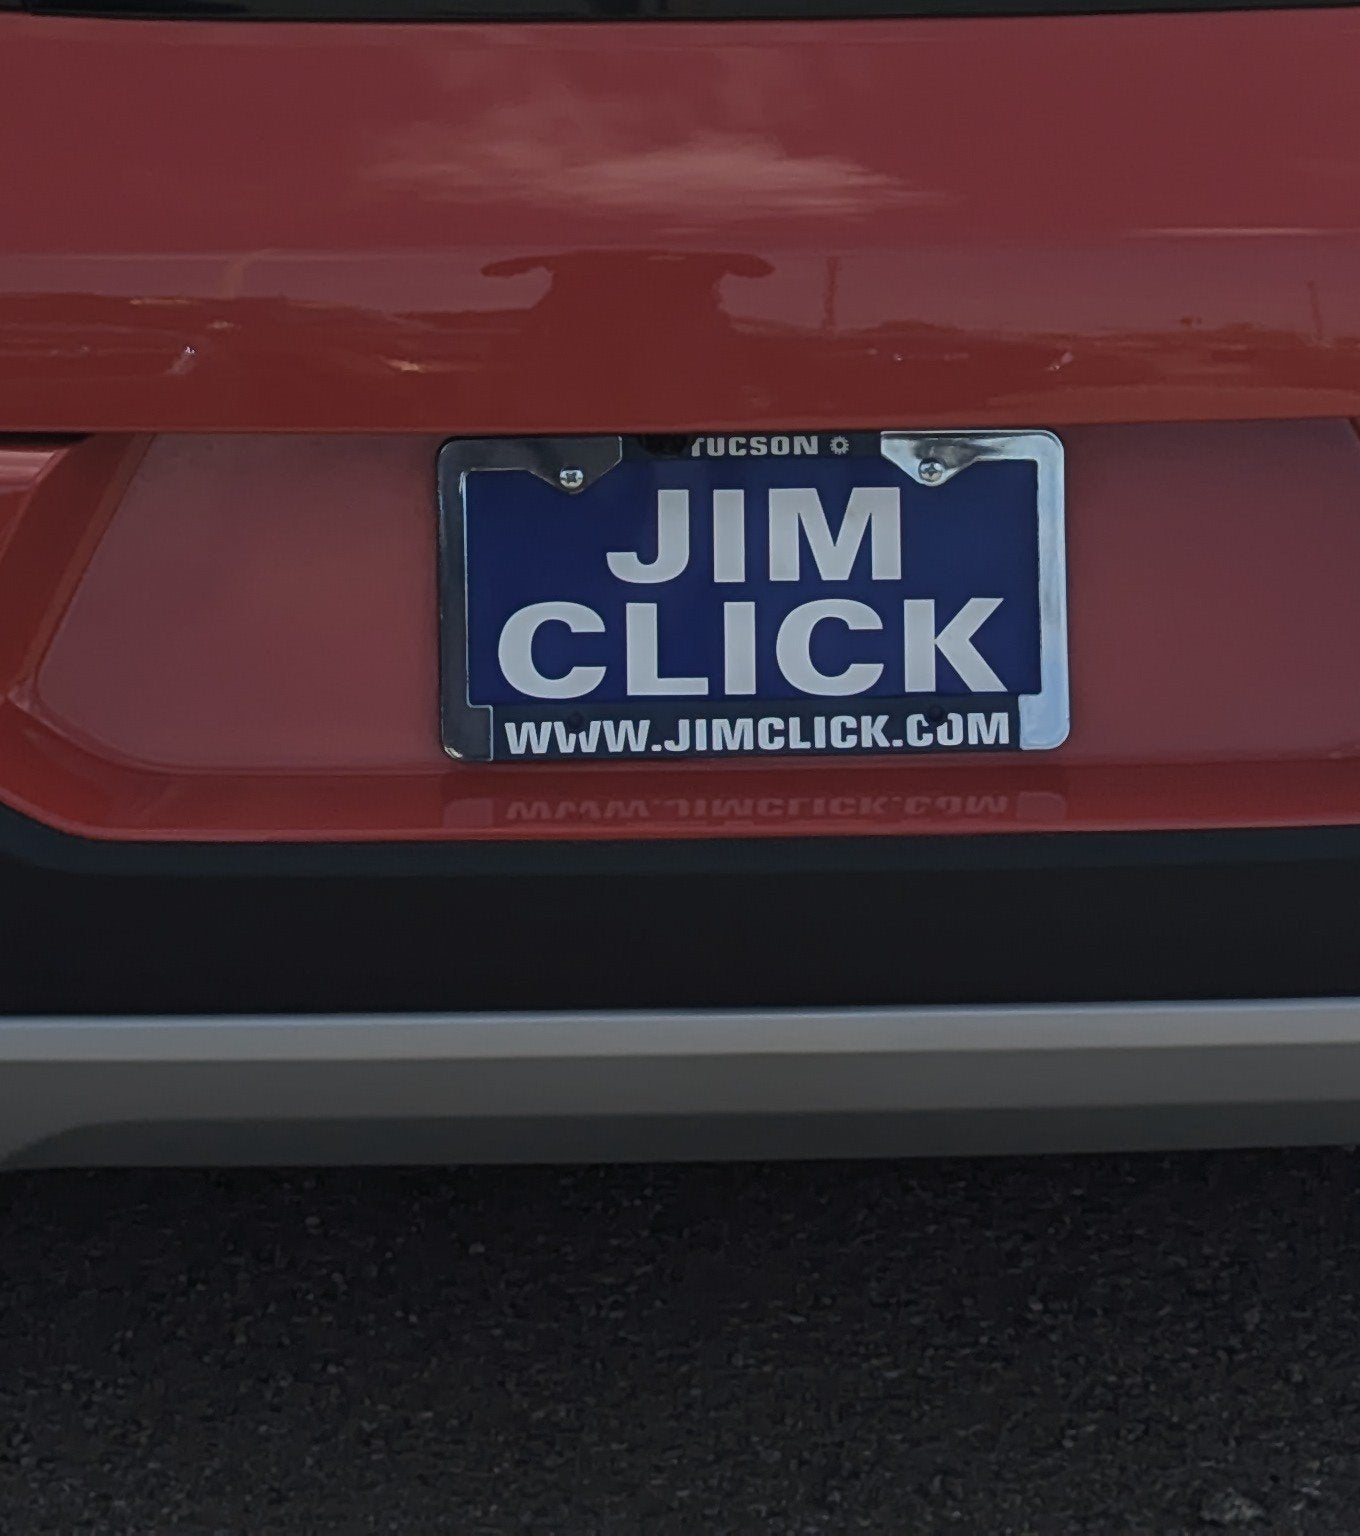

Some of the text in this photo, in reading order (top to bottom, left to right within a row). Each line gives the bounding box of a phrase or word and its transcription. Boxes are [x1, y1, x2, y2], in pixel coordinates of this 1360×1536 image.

[690, 436, 819, 457] TUCSON
[606, 486, 902, 584] JIM
[497, 597, 1008, 699] CLICK
[505, 712, 1011, 755] WWW.JIMCLICK.COM
